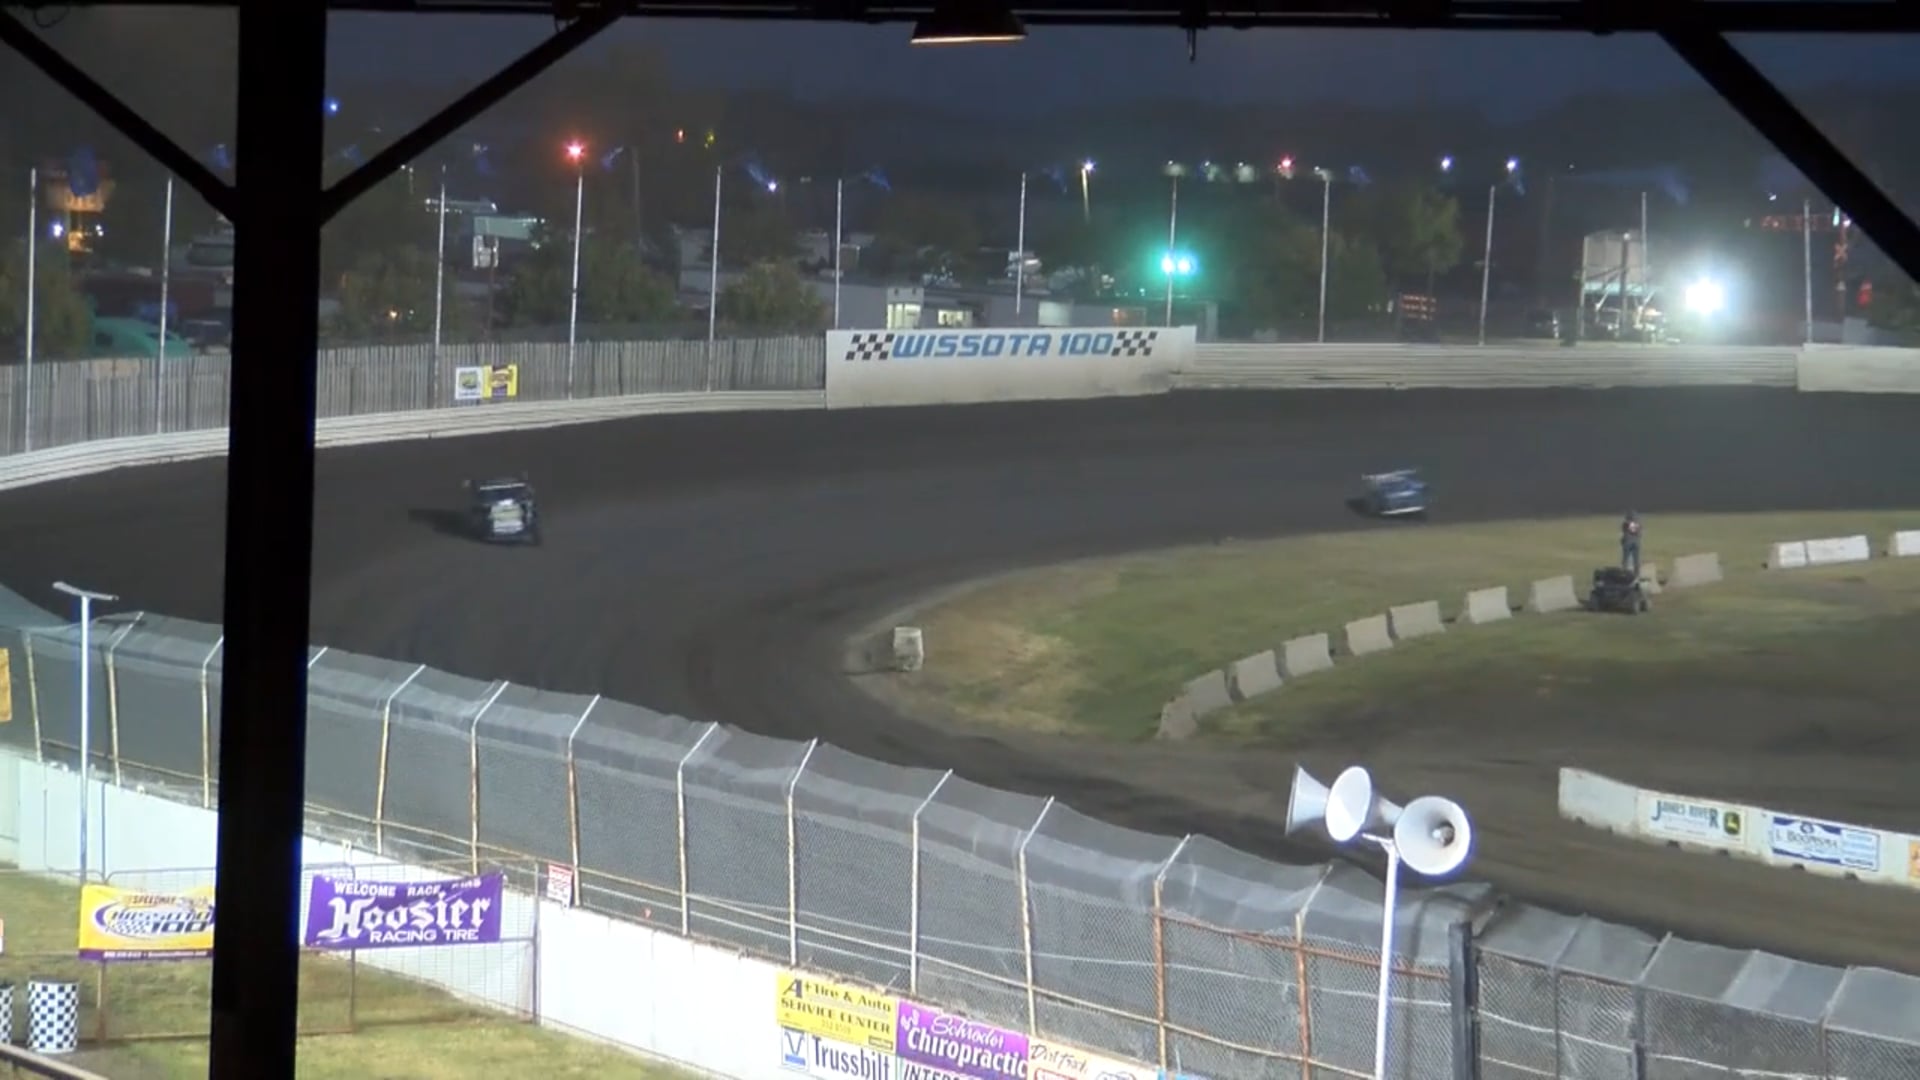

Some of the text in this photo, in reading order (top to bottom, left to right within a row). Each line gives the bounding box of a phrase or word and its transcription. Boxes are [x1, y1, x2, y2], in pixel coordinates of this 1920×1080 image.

[892, 333, 1114, 358] WISSOTA 100
[334, 882, 396, 897] WELCOME
[407, 885, 441, 897] RACE
[150, 920, 208, 934] 100
[317, 891, 492, 939] Hoosier
[370, 928, 480, 943] RACING TIRE
[843, 991, 852, 1003] &
[858, 994, 891, 1013] Auto
[781, 998, 834, 1018] SERVICE
[839, 1012, 891, 1035] CENTER
[812, 1035, 891, 1080] Trussbilt
[907, 1026, 1028, 1078] Chiropractic
